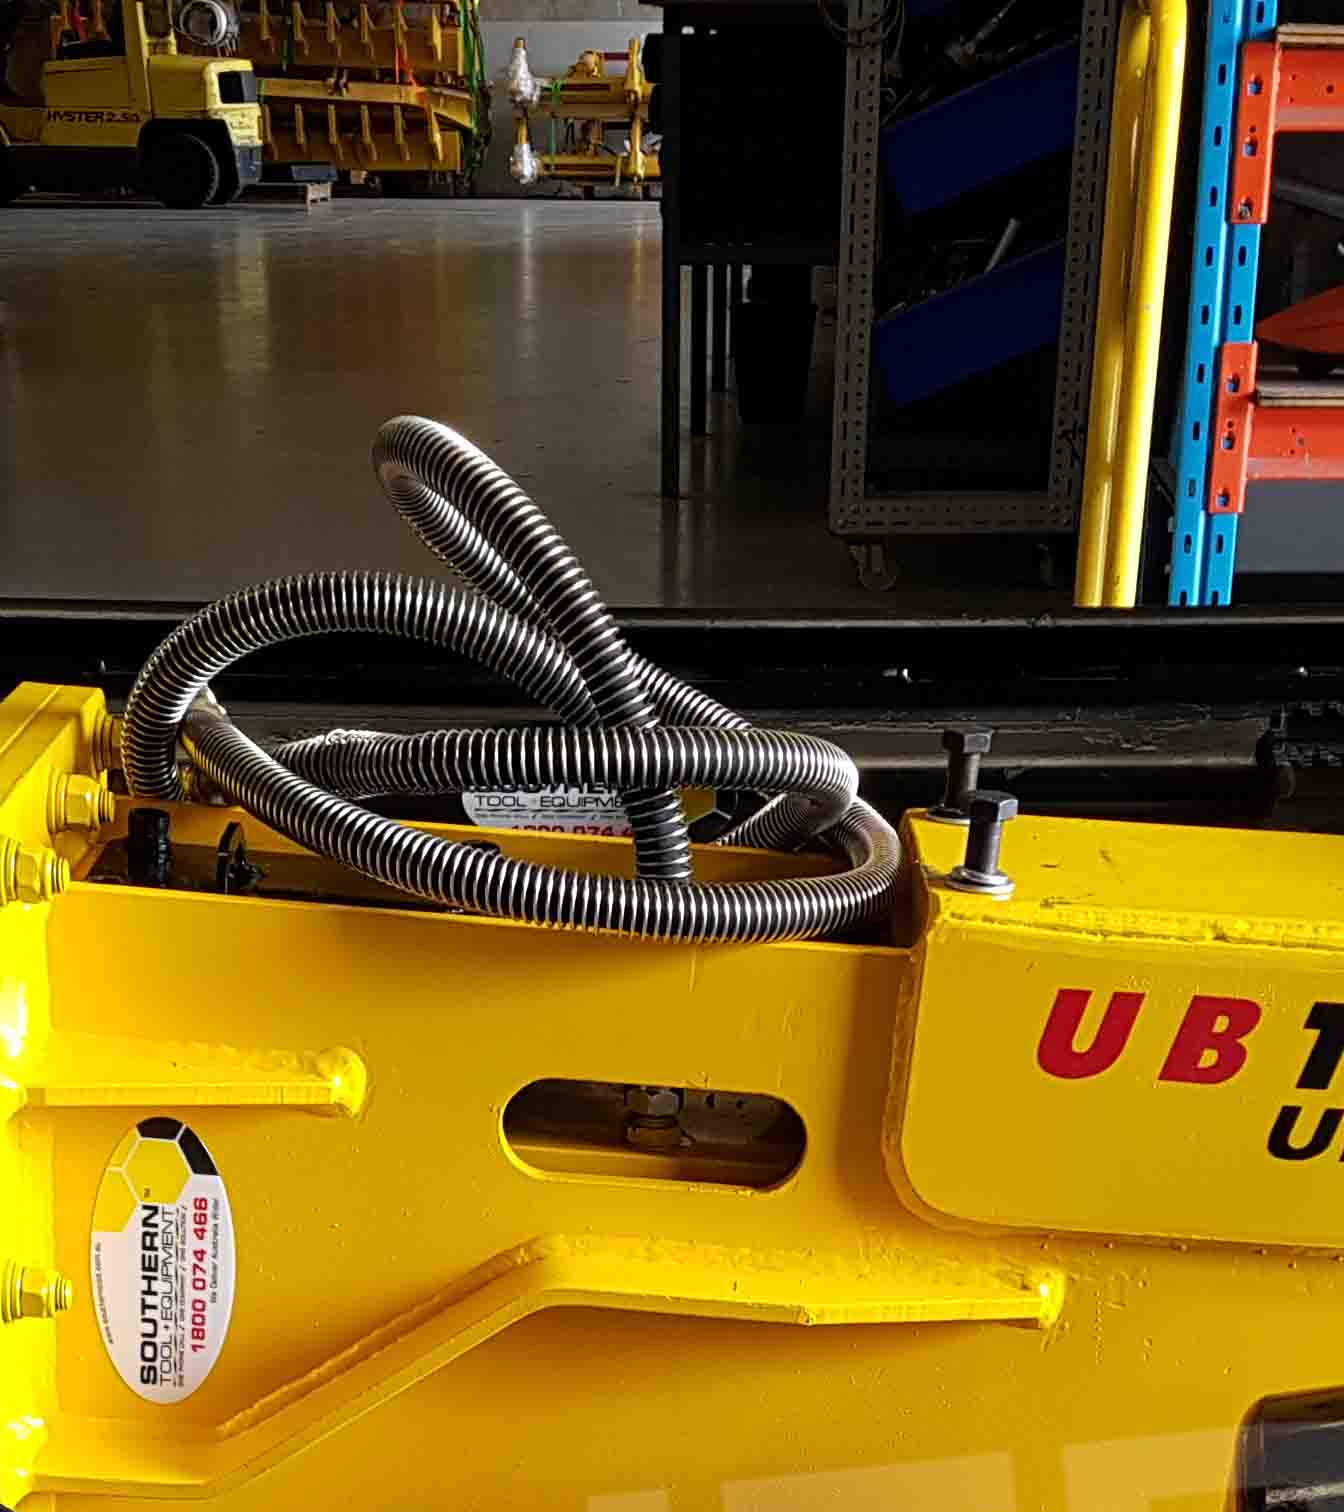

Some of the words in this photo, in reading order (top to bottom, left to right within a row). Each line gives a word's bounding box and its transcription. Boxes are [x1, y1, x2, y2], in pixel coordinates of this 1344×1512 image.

[474, 795, 528, 807] TOOL
[160, 1208, 177, 1320] EQUIPMENT
[192, 1248, 207, 1291] 074
[140, 1204, 159, 1386] SOUTHERN
[191, 1299, 207, 1353] 1800
[160, 1345, 174, 1387] TOOL
